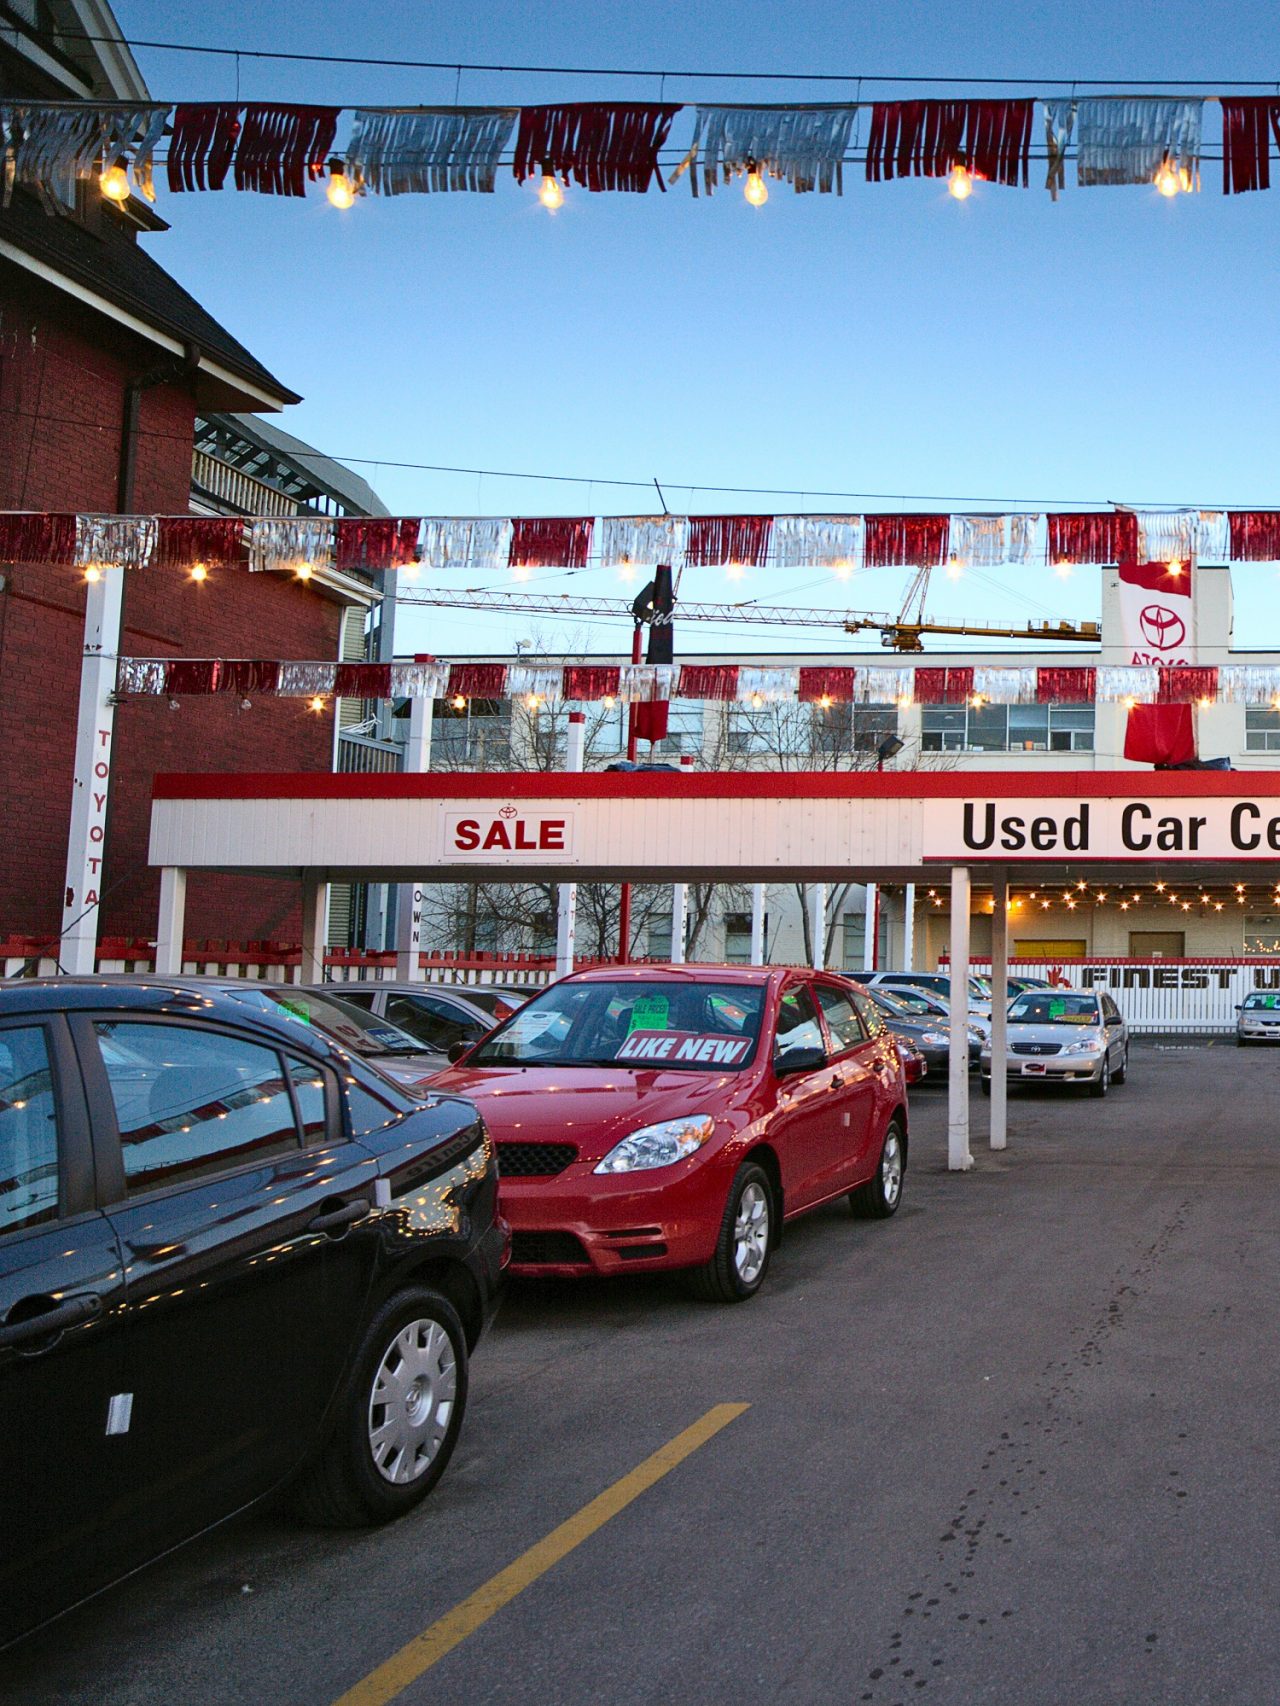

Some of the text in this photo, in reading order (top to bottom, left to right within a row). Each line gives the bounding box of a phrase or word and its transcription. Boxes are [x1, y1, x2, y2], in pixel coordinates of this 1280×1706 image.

[84, 730, 111, 905] TOYOTA
[963, 803, 1090, 851] Used
[1121, 802, 1207, 851] Car
[454, 820, 565, 851] SALE
[1082, 968, 1238, 989] FINEST
[619, 1038, 747, 1063] LIKE NEW
